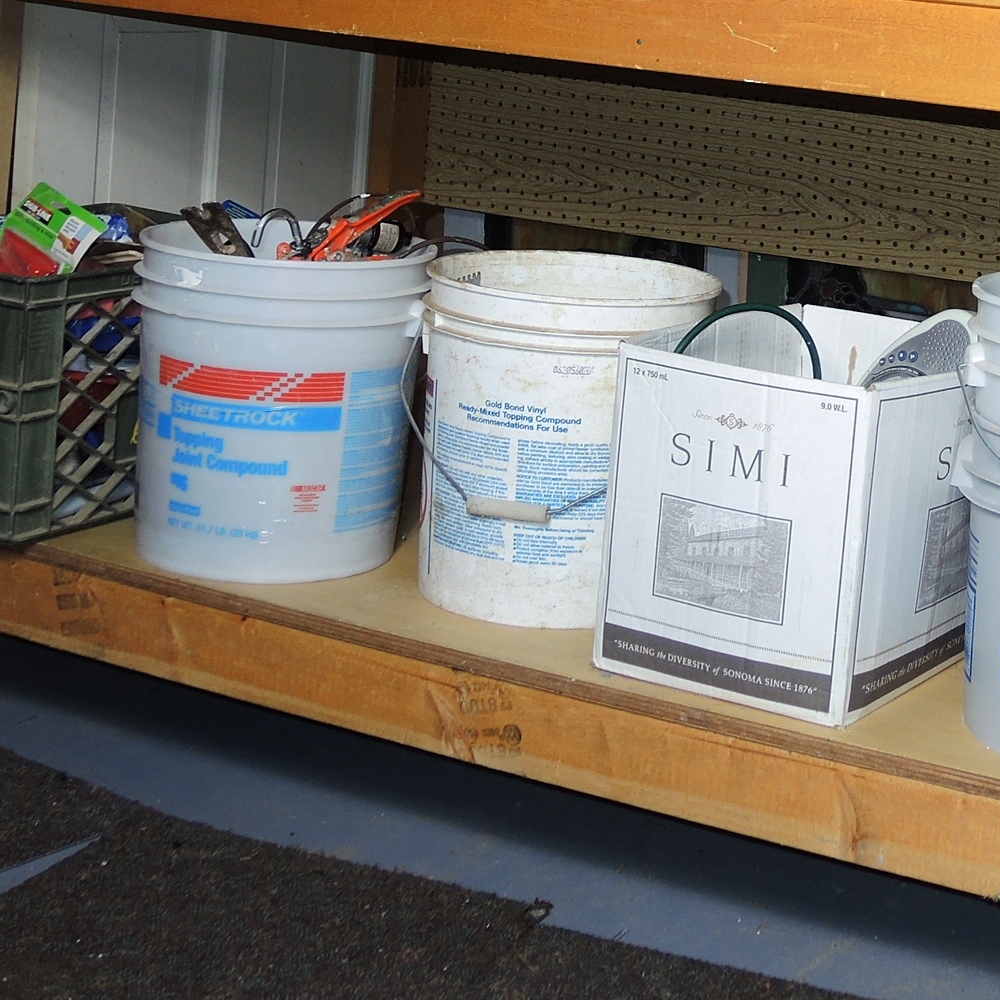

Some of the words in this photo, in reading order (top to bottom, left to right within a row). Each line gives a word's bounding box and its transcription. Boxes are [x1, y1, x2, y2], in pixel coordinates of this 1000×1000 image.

[633, 367, 641, 375] 12
[647, 370, 658, 378] 750
[174, 398, 297, 427] SHEETROCK
[458, 402, 501, 418] Ready-Mixed
[502, 411, 534, 424] Topping
[535, 414, 582, 426] Compound
[485, 399, 502, 410] Gold
[504, 402, 525, 412] Bond
[527, 405, 547, 415] Vinyl
[466, 413, 534, 431] Recommendations
[536, 424, 551, 433] For
[552, 425, 568, 434] Use
[174, 426, 224, 453] Topping
[172, 448, 203, 468] Joint
[206, 454, 288, 477] Compound
[670, 433, 791, 487] SIMI
[667, 653, 711, 672] DIVERSITY
[722, 668, 762, 685] SONOMA
[764, 677, 792, 691] SINCE
